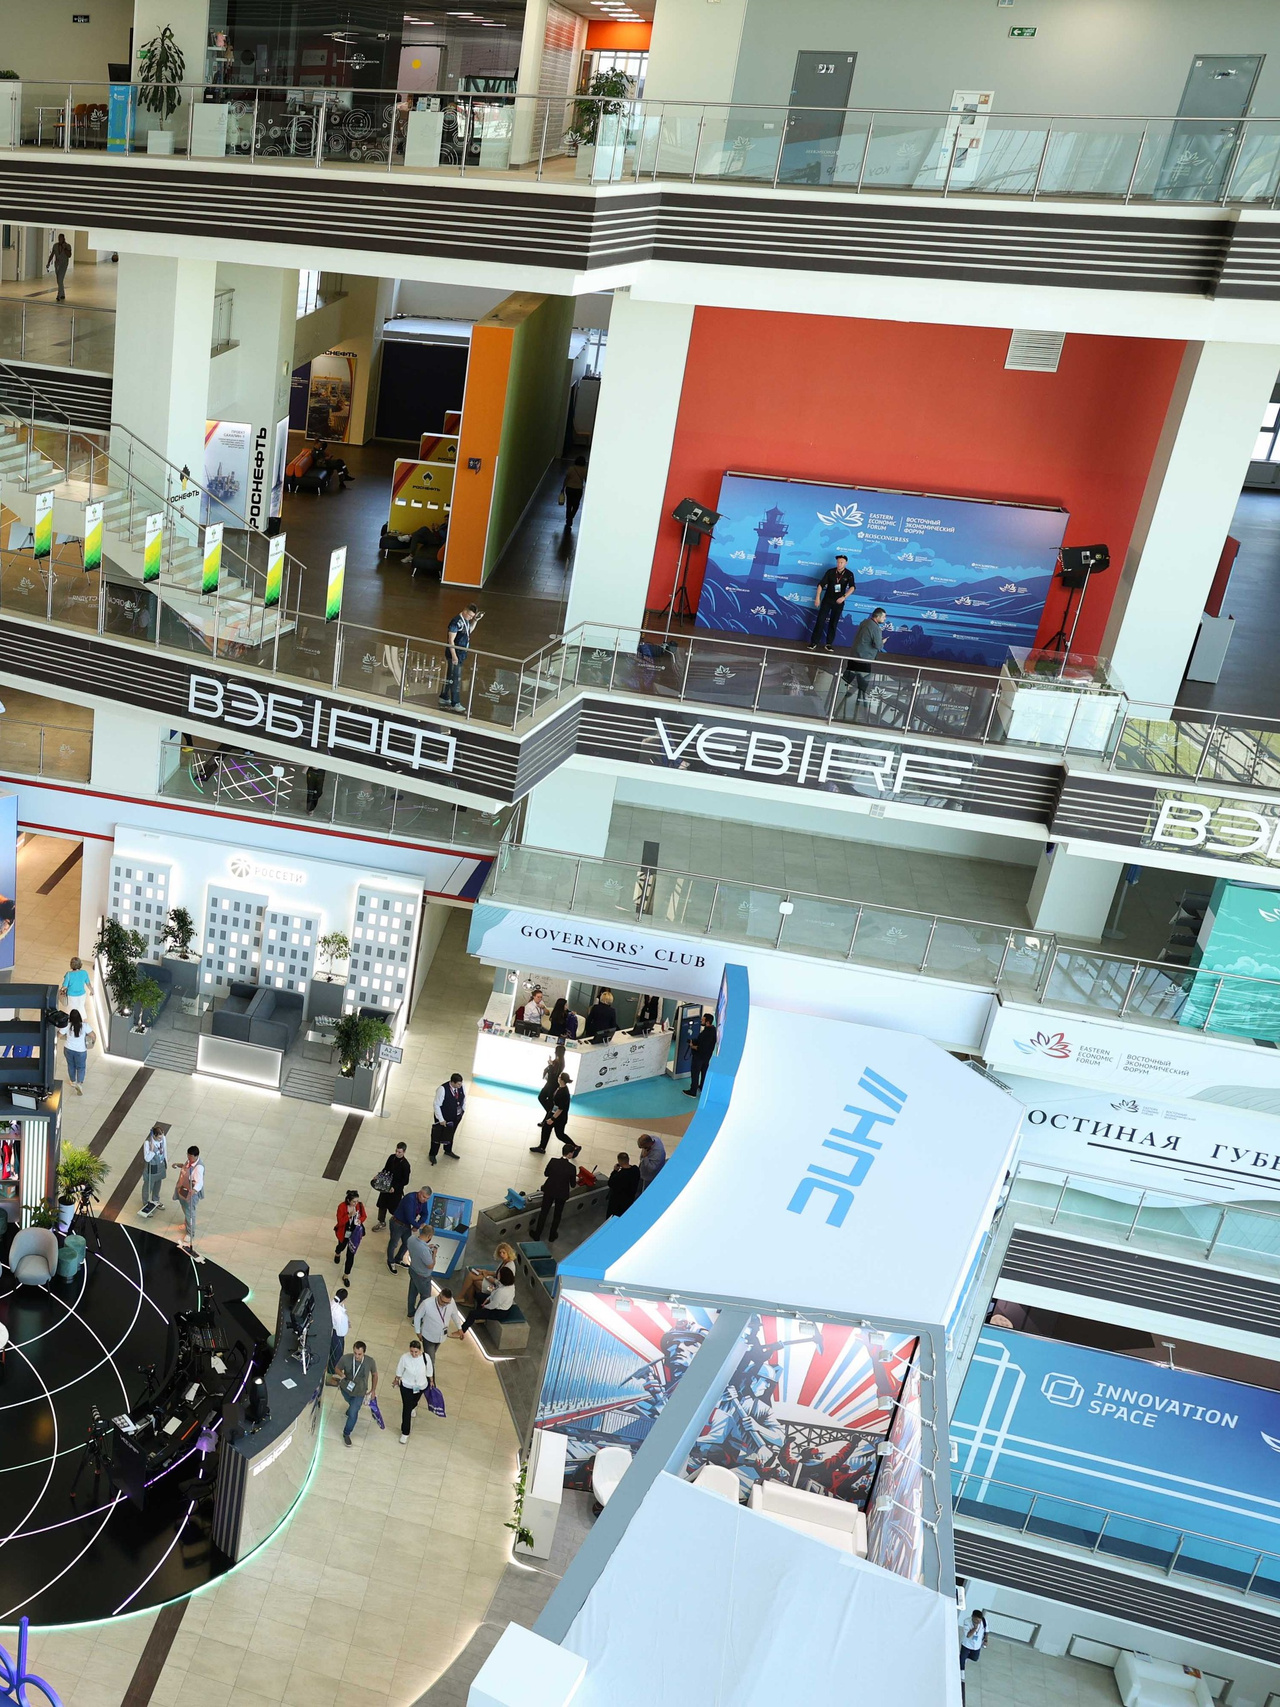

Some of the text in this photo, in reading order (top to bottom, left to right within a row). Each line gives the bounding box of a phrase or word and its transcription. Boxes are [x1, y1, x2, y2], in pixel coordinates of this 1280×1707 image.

[320, 350, 358, 358] СНЕФТЬ
[249, 427, 267, 530] РОСНЕФТЬ
[170, 490, 200, 503] ОСНЕФТЬ
[868, 519, 896, 527] ECONOMIC
[905, 523, 955, 533] ЭКОНОМИЧЕСКИЙ
[906, 517, 941, 526] ВОСТОЧНЫЙ
[864, 533, 909, 543] ROSCONGRESS
[1151, 798, 1280, 856] ВЭ
[254, 867, 304, 884] РОССЕТИ
[654, 949, 706, 968] CLUB
[1079, 1045, 1110, 1055] EASTERN
[1076, 1057, 1101, 1066] FORUM
[1078, 1051, 1114, 1063] ECONOMIC
[1126, 1053, 1172, 1066] ВОСТОЧНЫЙ
[1123, 1066, 1149, 1075] ФОРУМ
[1124, 1060, 1190, 1077] ЭКОНОМИЧЕСКИЙ
[1026, 1109, 1182, 1151] ОСТИНАЯ
[1093, 1382, 1239, 1429] INNOVATION
[1087, 1400, 1159, 1428] SPACE
